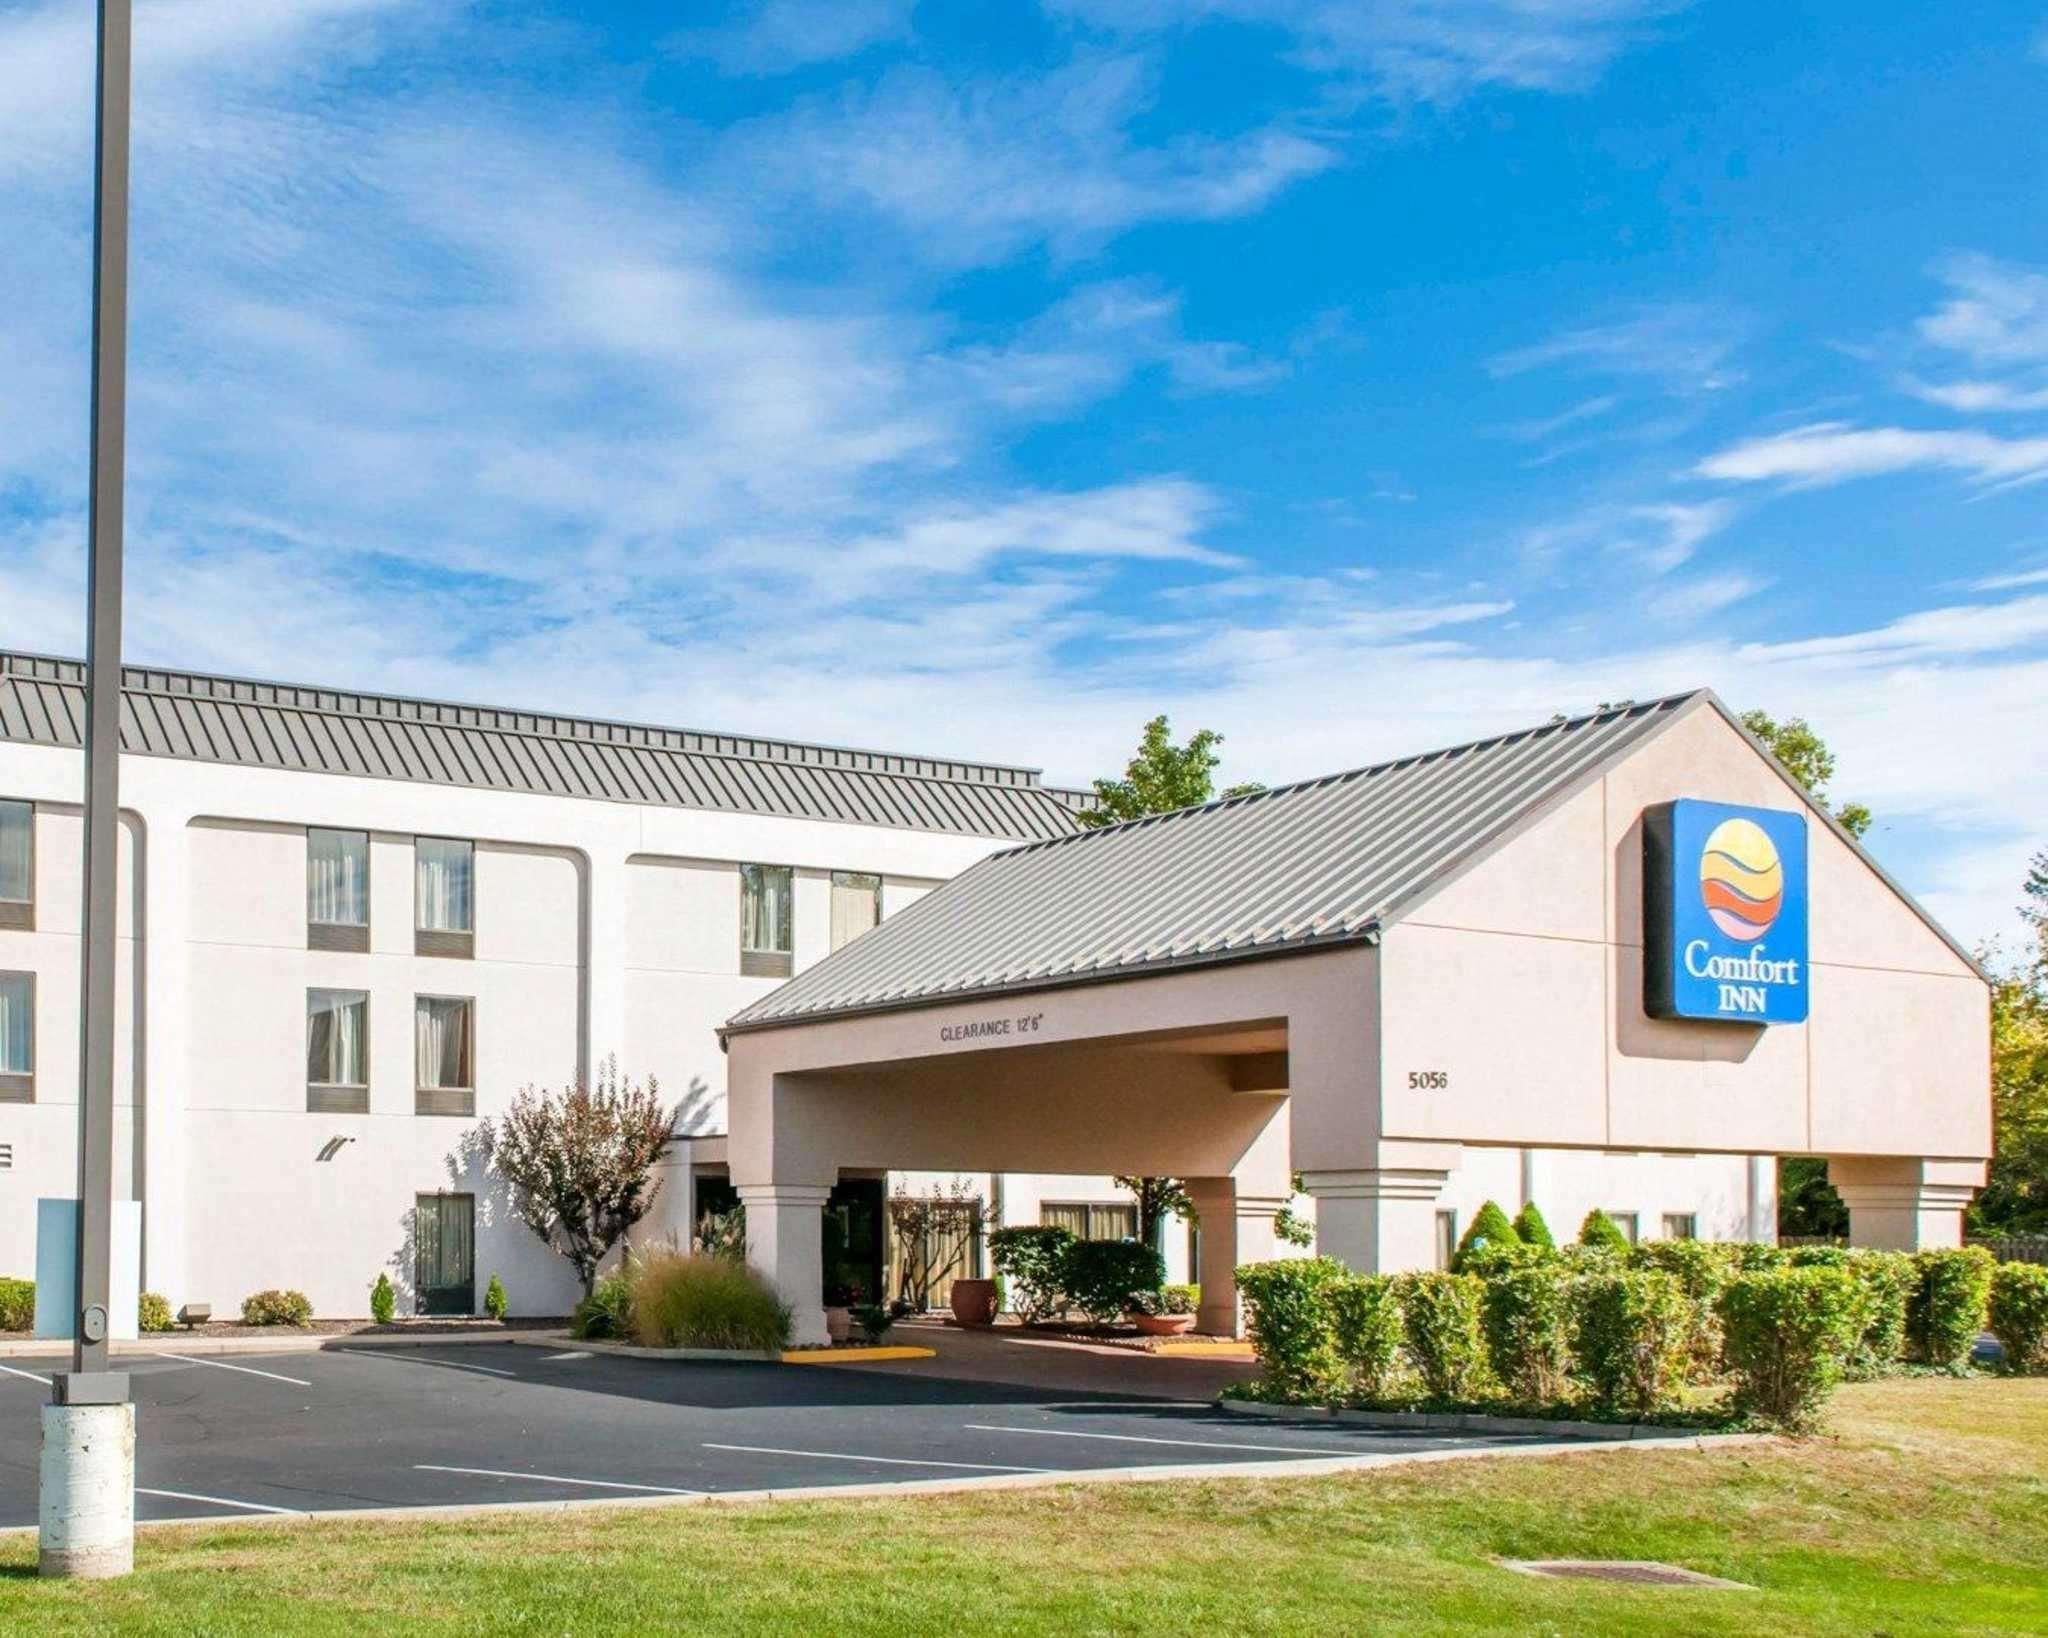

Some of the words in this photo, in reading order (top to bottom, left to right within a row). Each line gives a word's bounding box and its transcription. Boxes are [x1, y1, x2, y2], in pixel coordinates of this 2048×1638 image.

[1684, 939, 1799, 985] Comfort
[1718, 985, 1766, 1013] INN
[940, 1019, 1011, 1041] CLEARANCE
[1408, 1071, 1448, 1089] 5056
